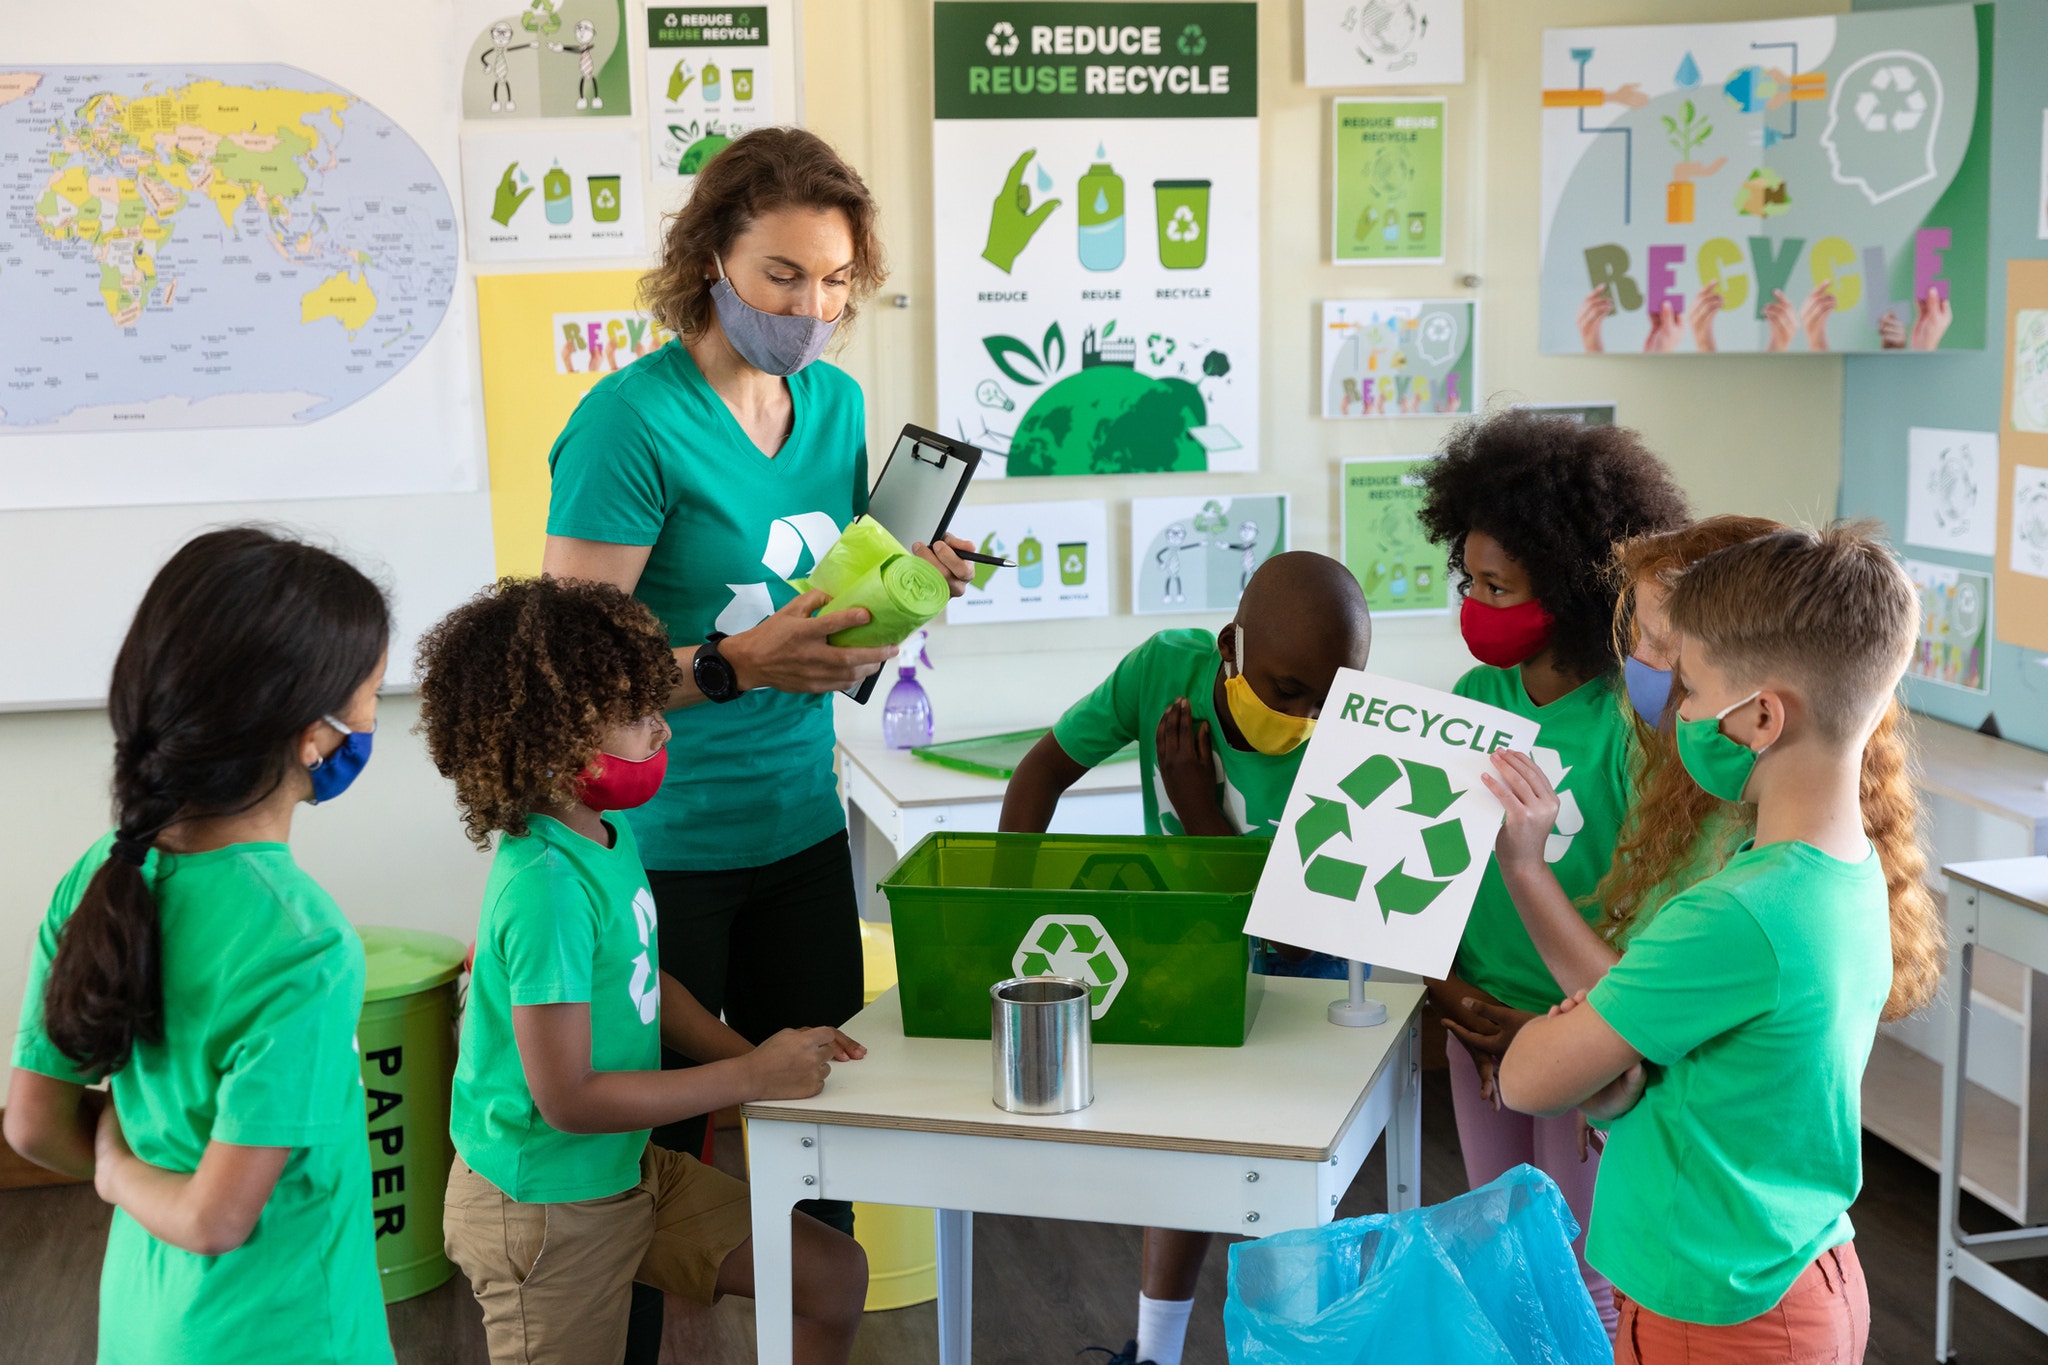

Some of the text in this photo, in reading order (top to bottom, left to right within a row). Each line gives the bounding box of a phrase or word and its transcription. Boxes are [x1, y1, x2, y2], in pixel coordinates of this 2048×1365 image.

[658, 27, 760, 40] REUSE RECYCLE
[681, 14, 733, 27] REDUCE
[1031, 26, 1162, 55] REDUCE
[969, 65, 1230, 94] REUSE RECYCLE
[1343, 117, 1393, 128] REDUCE
[1583, 228, 1952, 328] RECYCLE
[978, 288, 1211, 302] REDUCE REUSE RECYCLE
[1343, 373, 1460, 411] RECYCLE
[1340, 692, 1513, 754] RECYCLE
[366, 1046, 405, 1240] PAPER
